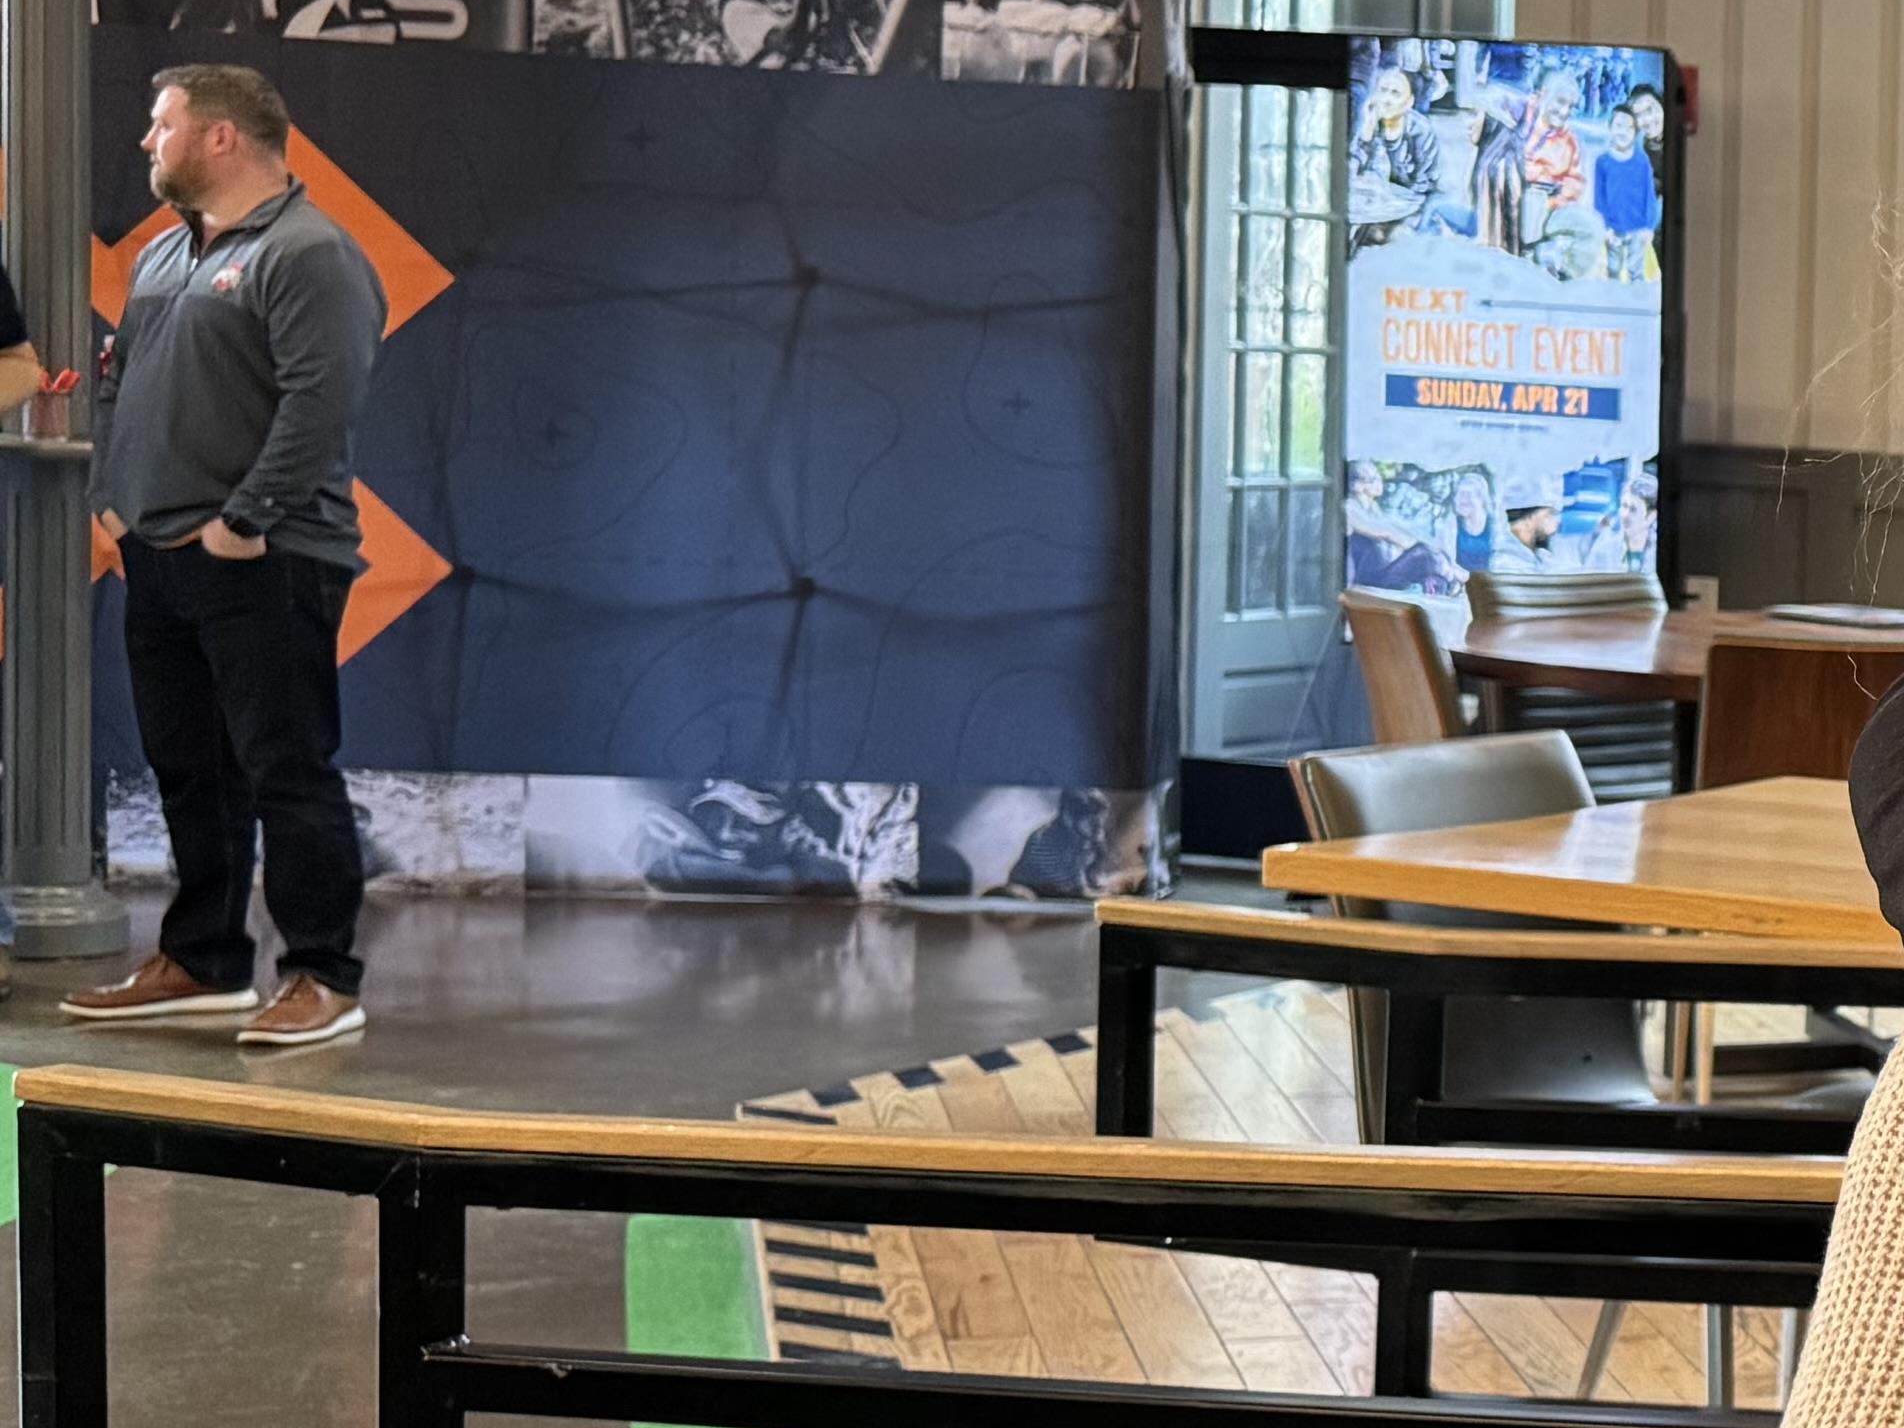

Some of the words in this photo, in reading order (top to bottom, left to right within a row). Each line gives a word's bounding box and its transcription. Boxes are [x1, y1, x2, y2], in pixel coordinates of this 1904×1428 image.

[1383, 286, 1469, 313] NEXT
[1382, 318, 1520, 371] CONNECT
[1532, 325, 1627, 376] EVENT
[1512, 384, 1559, 414] APR
[1563, 387, 1590, 417] 21
